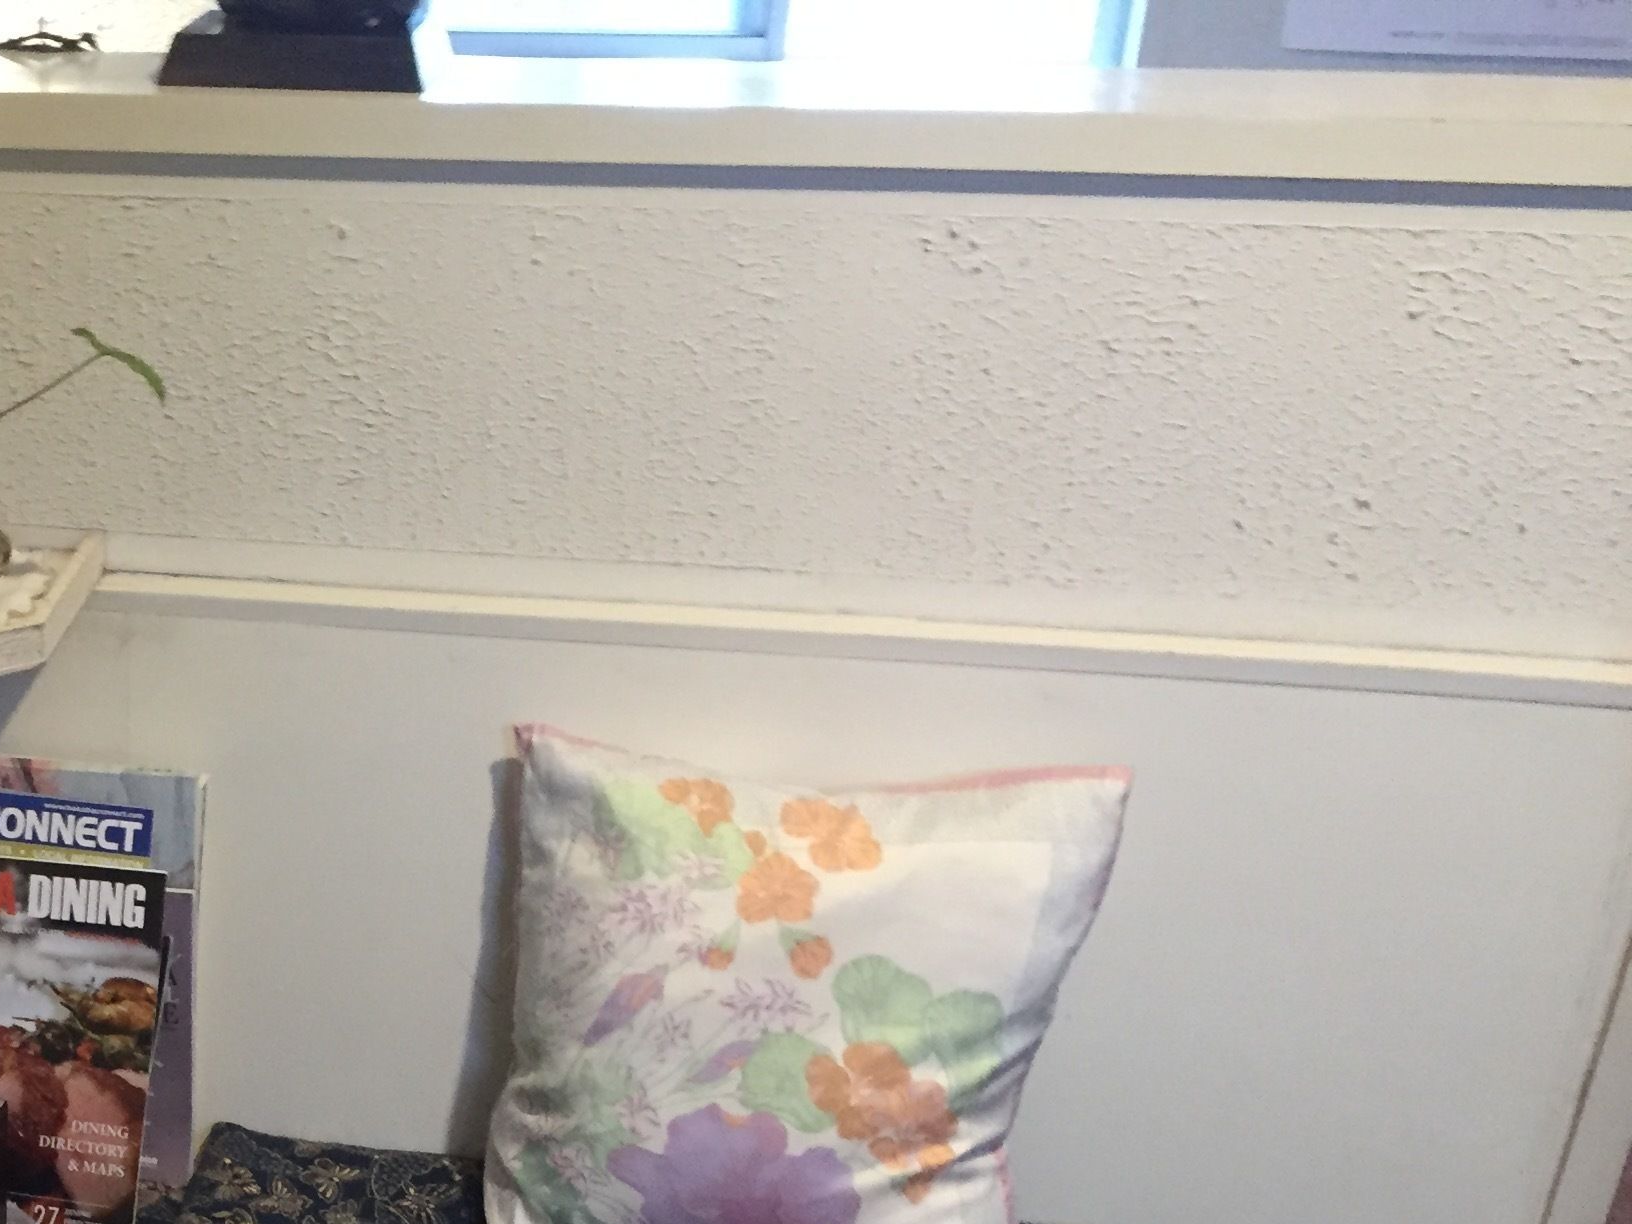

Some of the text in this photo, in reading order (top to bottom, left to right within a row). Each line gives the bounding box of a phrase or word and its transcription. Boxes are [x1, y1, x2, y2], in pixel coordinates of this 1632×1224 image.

[27, 873, 147, 929] DINING
[71, 1119, 130, 1140] DINING
[39, 1134, 129, 1159] DIRECTORY
[67, 1158, 80, 1173] &
[82, 1160, 126, 1178] MAPS
